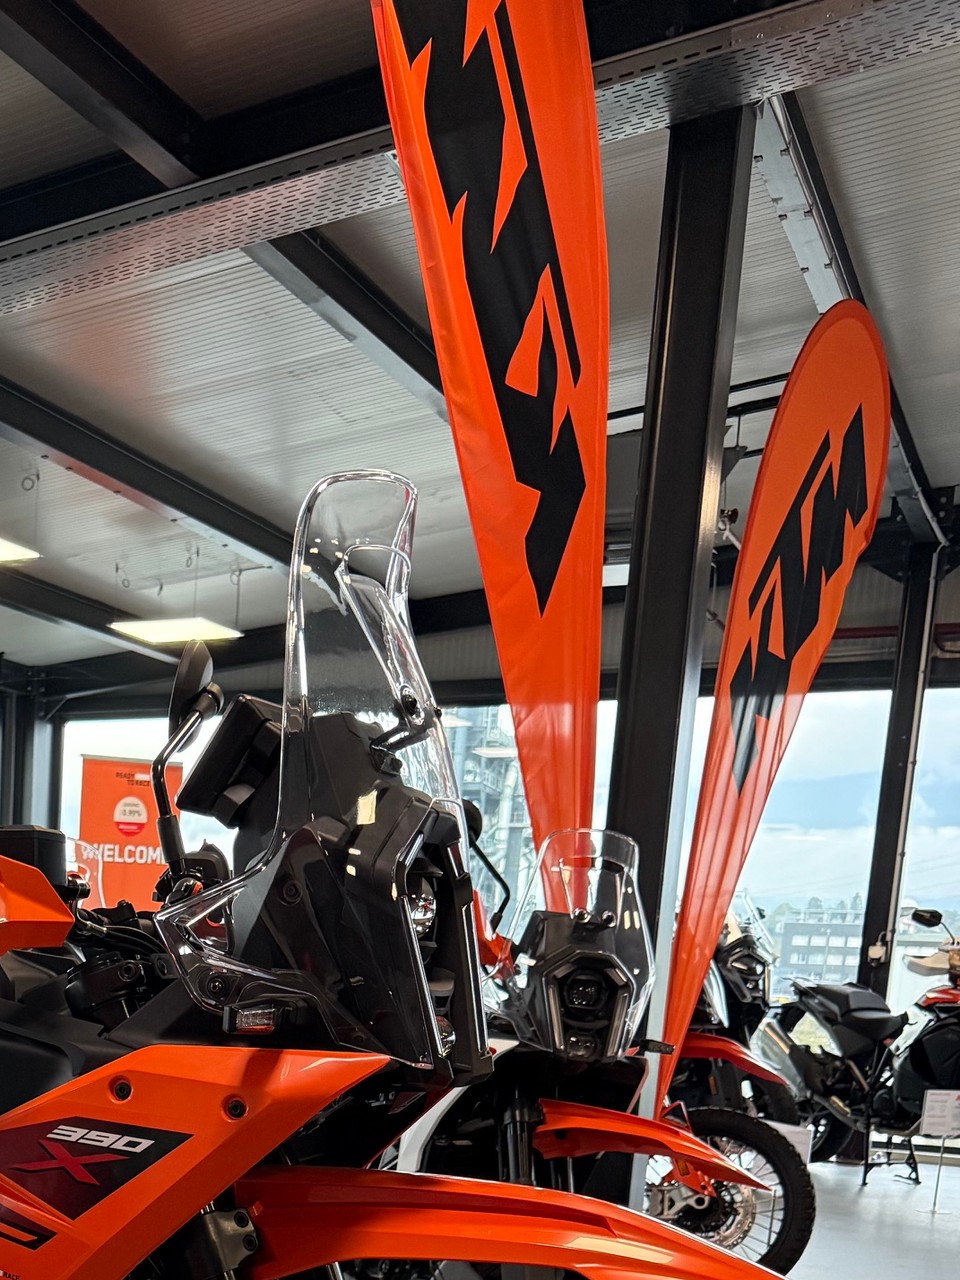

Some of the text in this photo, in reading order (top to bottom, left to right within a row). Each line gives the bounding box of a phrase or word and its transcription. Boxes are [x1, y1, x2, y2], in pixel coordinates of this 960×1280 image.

[730, 402, 868, 798] KTM
[82, 843, 167, 865] WELCOM
[45, 1124, 156, 1153] 390
[10, 1139, 131, 1186] X
